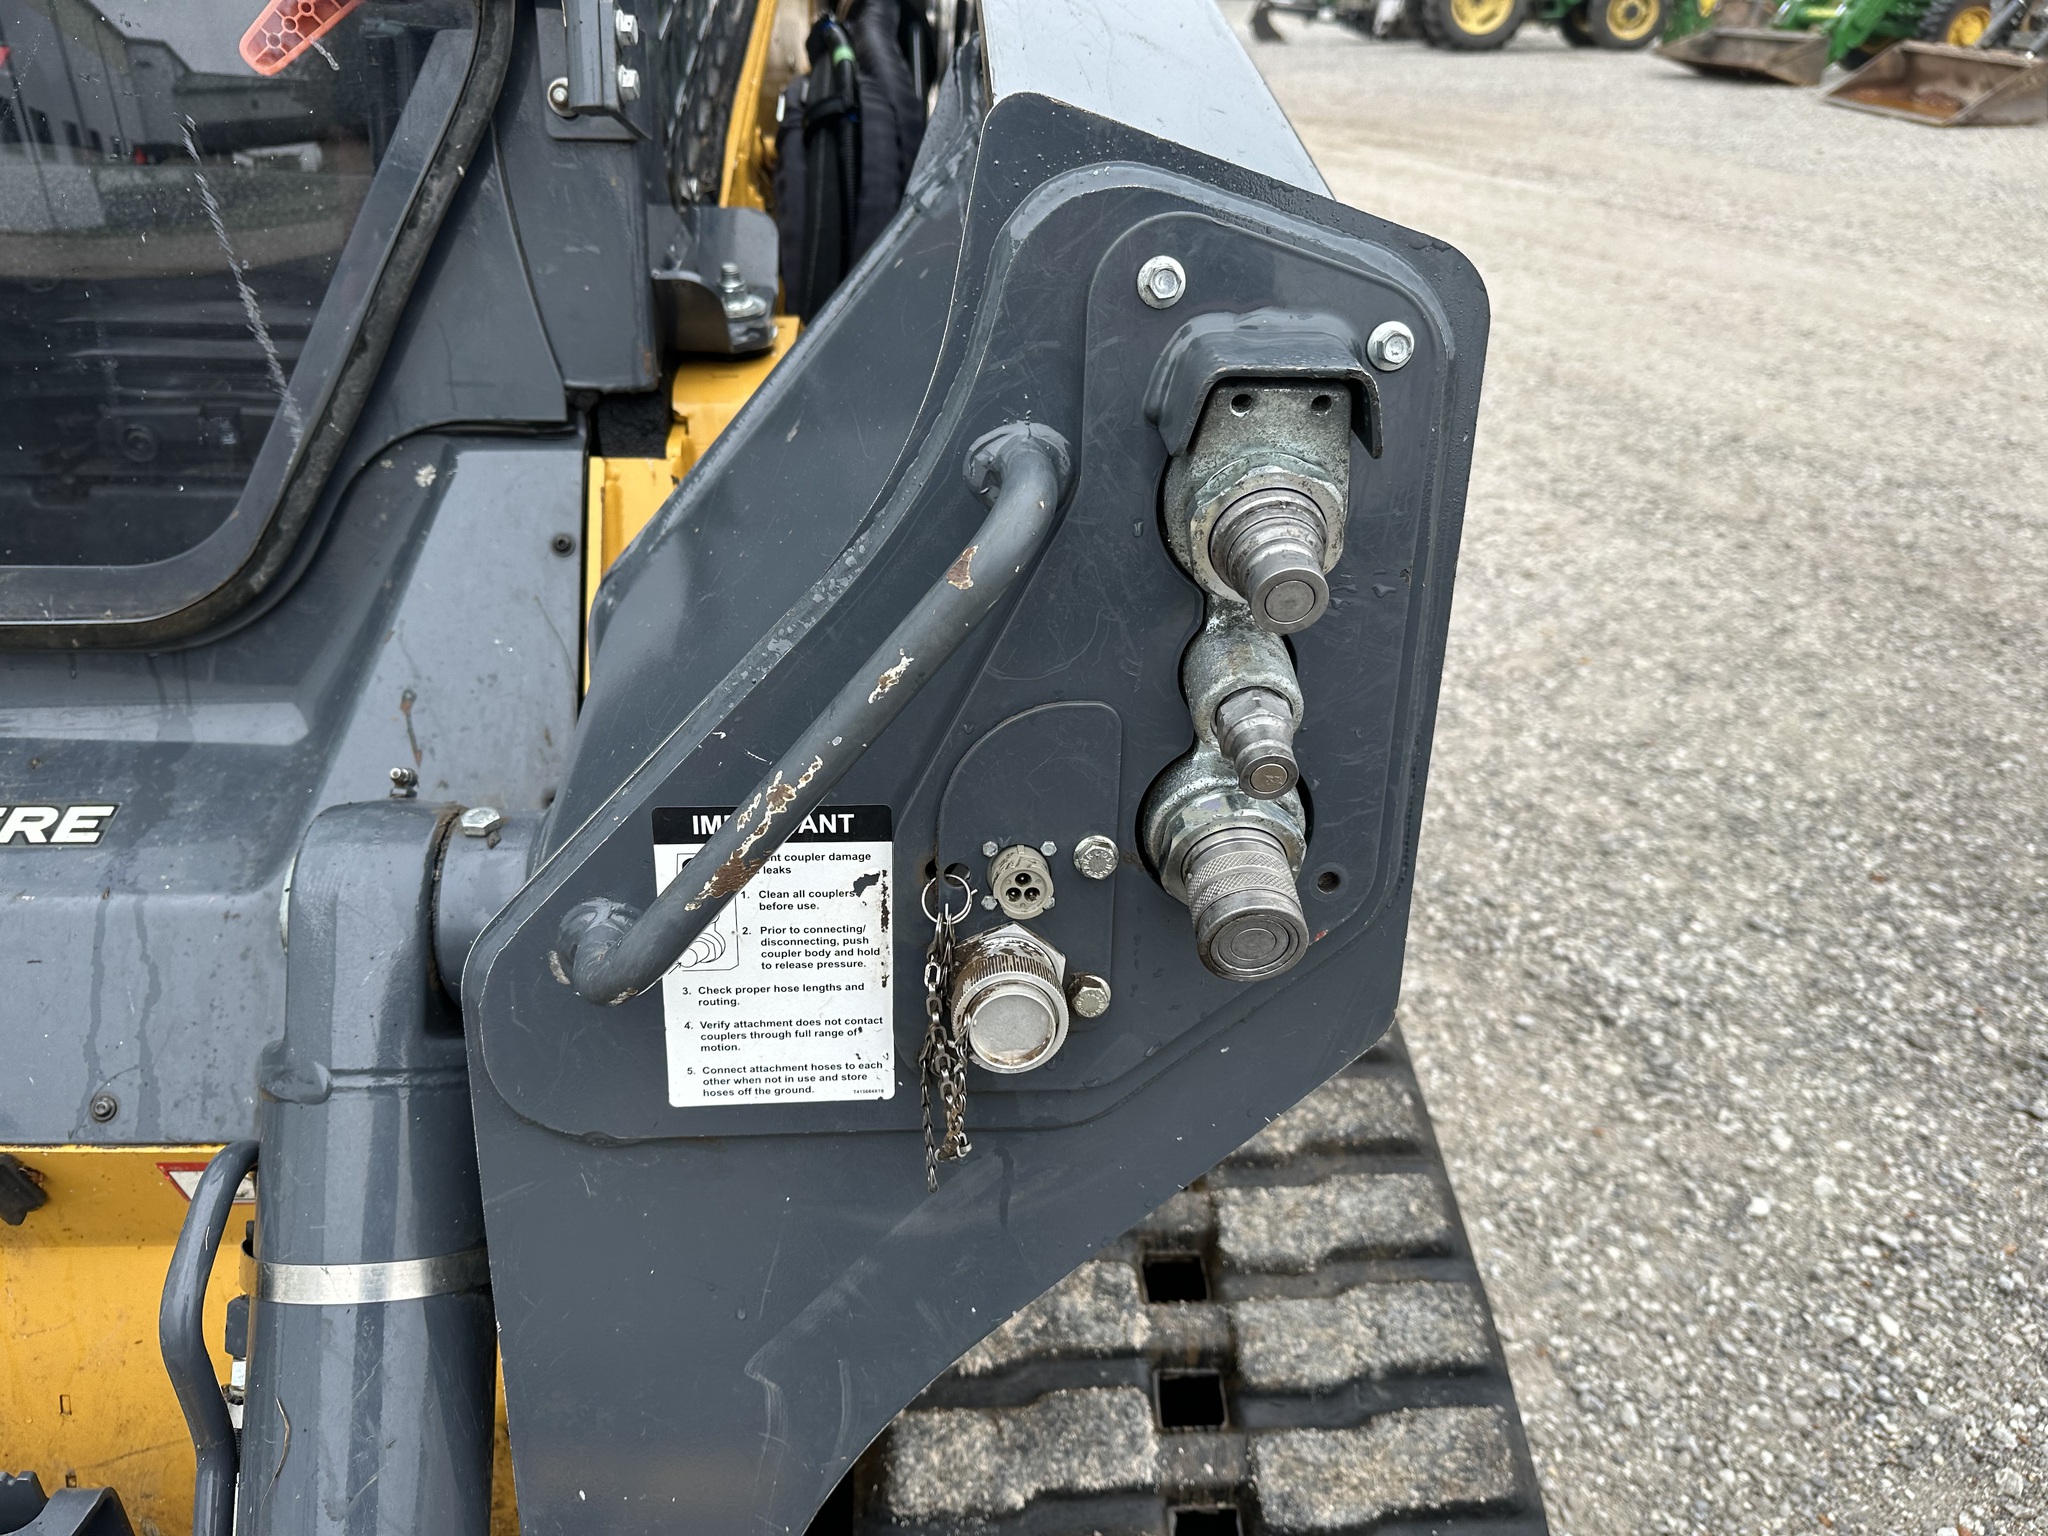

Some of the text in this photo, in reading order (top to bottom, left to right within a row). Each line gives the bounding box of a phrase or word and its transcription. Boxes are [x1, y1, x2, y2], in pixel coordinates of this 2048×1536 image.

[0, 806, 115, 843] RE
[692, 813, 855, 835] IMANT
[784, 853, 825, 863] coupler
[829, 853, 871, 862] damage
[763, 866, 792, 874] leaks
[740, 889, 855, 900] 1. Clean all couplers
[759, 901, 794, 911] before
[742, 924, 867, 935] 2. Prior to connecting/
[760, 936, 869, 947] disconnecting, push
[760, 947, 880, 960] coupler body and hold
[761, 961, 866, 970] to release pressure.
[682, 982, 865, 996] 3. Check proper hose lengths and
[698, 997, 740, 1008] routing.
[684, 1016, 883, 1031] 4. Verify attachment does not contact
[700, 1028, 858, 1043] couplers through full range of
[700, 1044, 741, 1052] motion.
[687, 1061, 883, 1075] 5. Connect attachment hoses to each
[702, 1077, 734, 1086] other
[734, 1076, 762, 1085] when
[764, 1075, 782, 1084] not
[819, 1073, 838, 1082] and
[841, 1073, 868, 1081] store
[703, 1086, 815, 1097] hoses off the ground.
